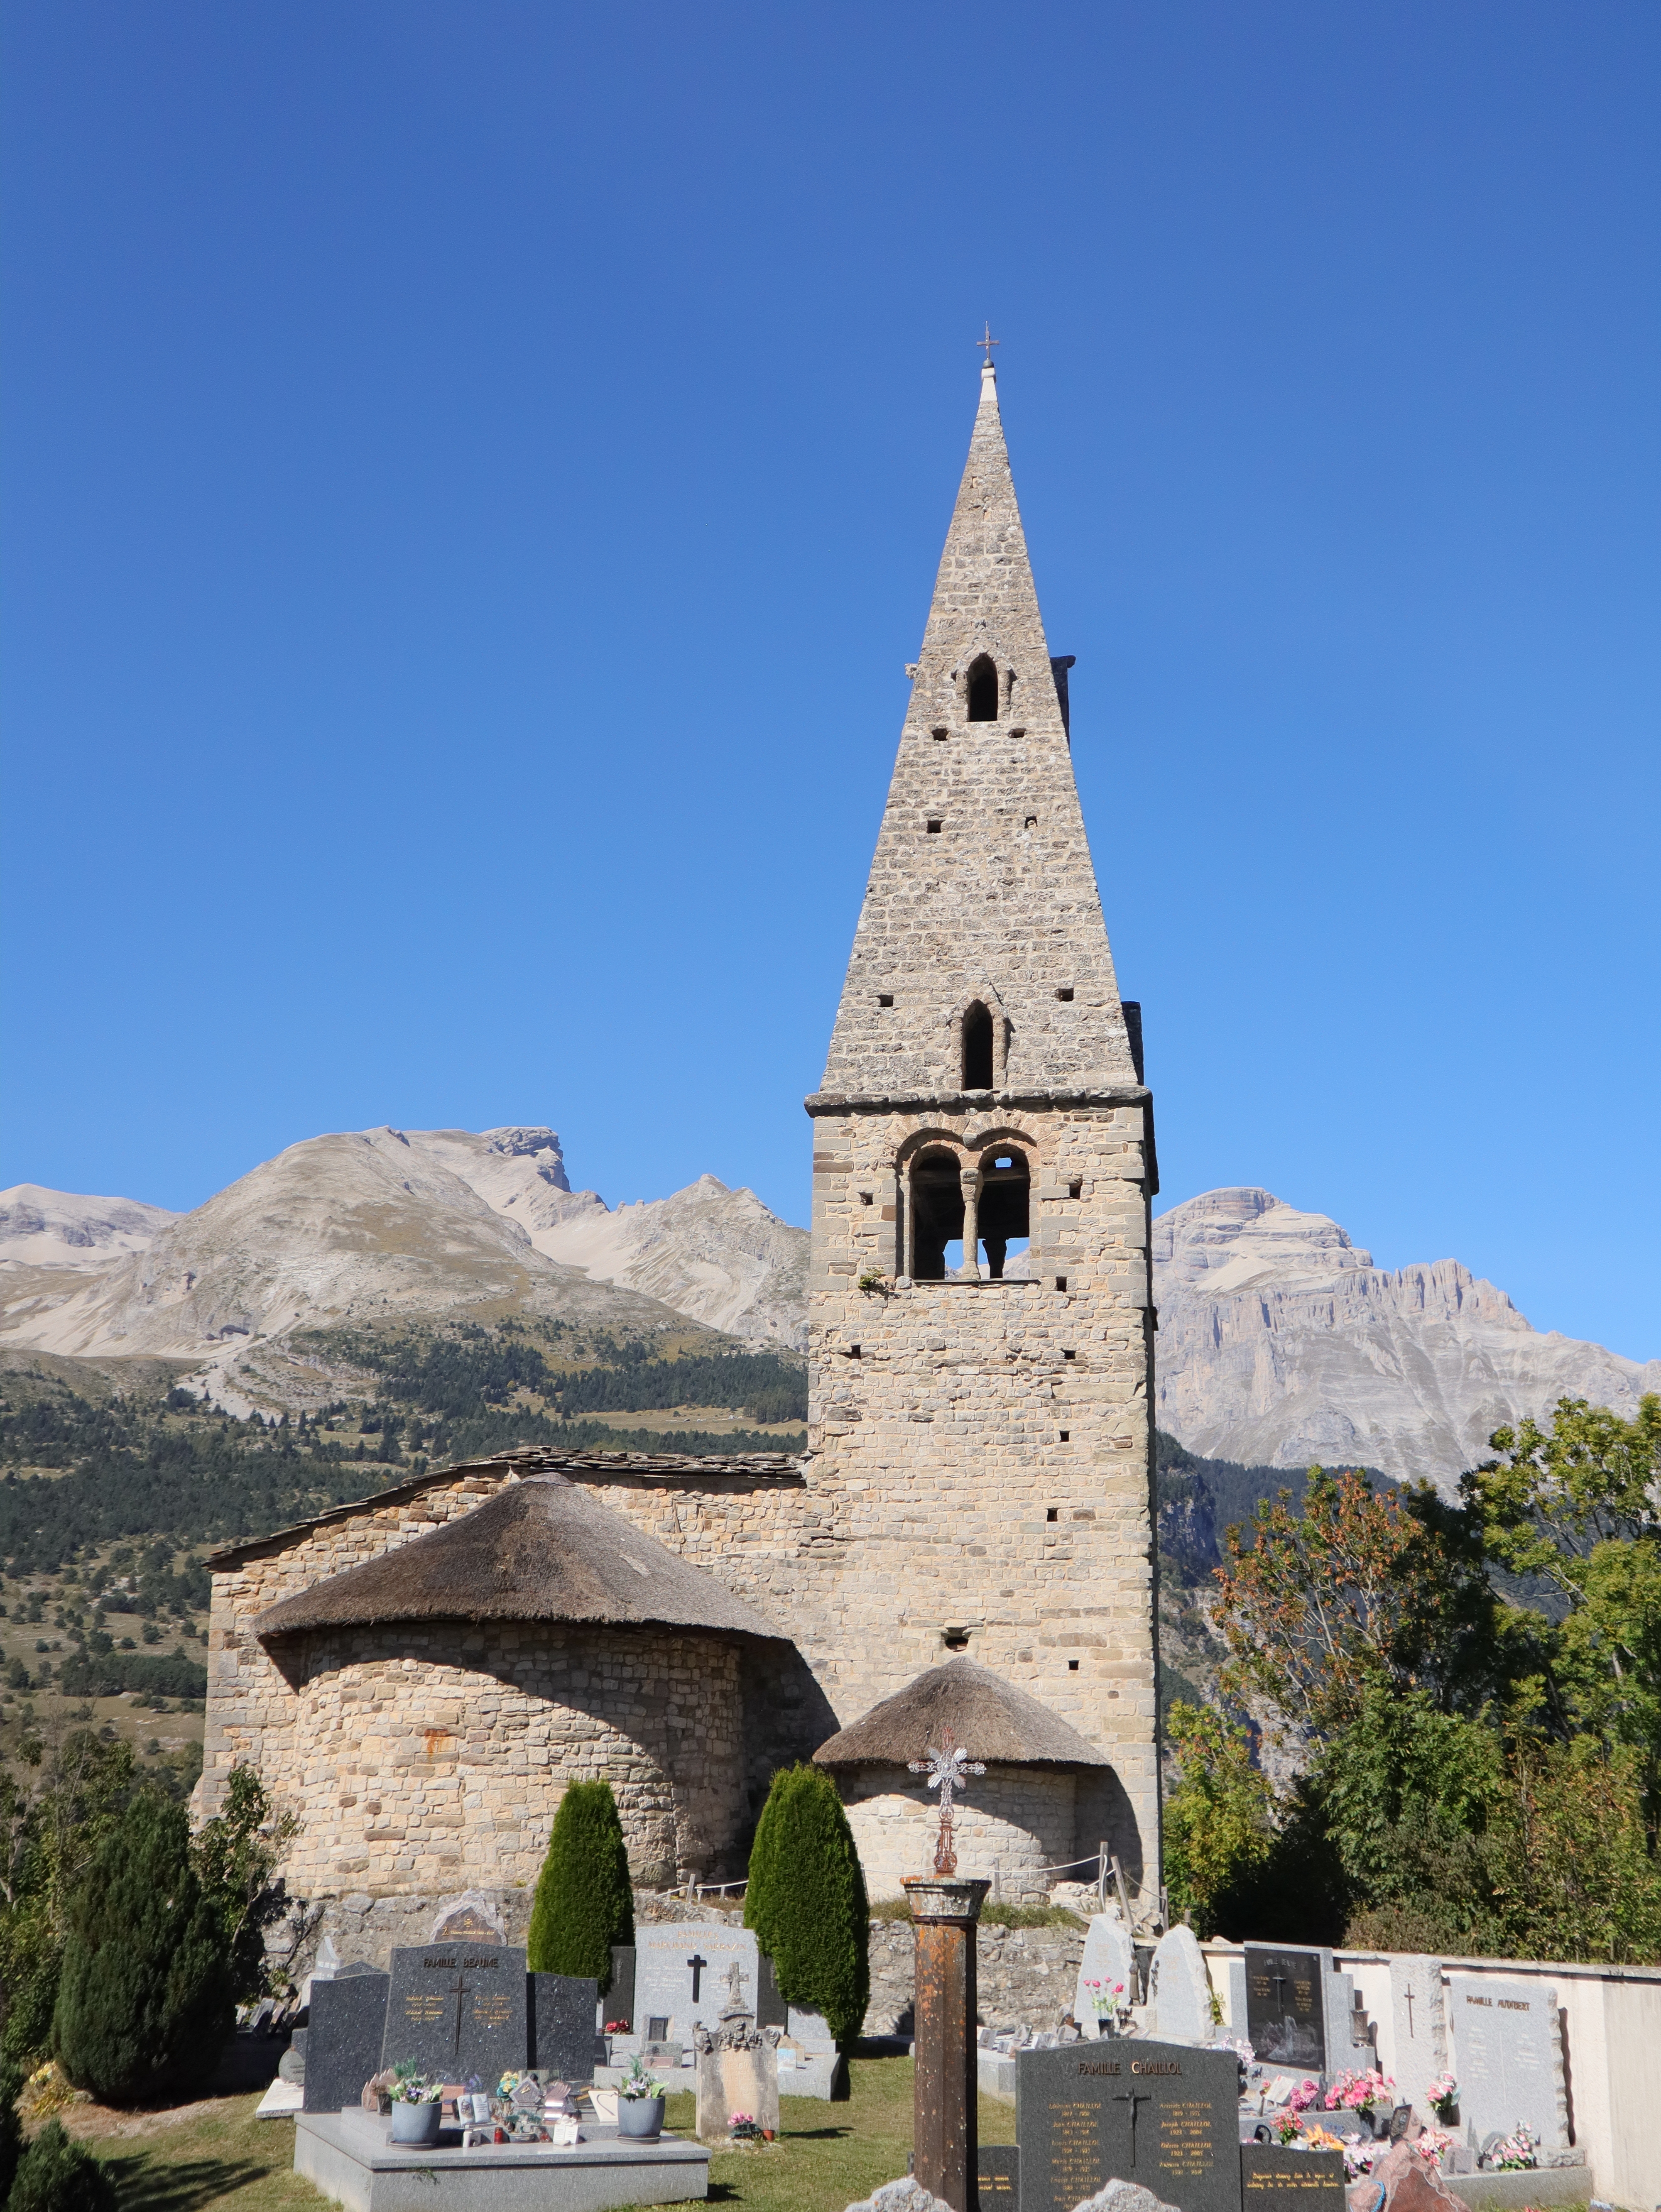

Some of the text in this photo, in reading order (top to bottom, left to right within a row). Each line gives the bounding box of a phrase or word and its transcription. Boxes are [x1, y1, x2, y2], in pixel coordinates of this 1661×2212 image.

[424, 1958, 499, 1968] FAMILLE BEAUME
[1466, 1995, 1493, 2007] FAMILLE
[1078, 2061, 1182, 2075] FAMILLE CHAILLOL
